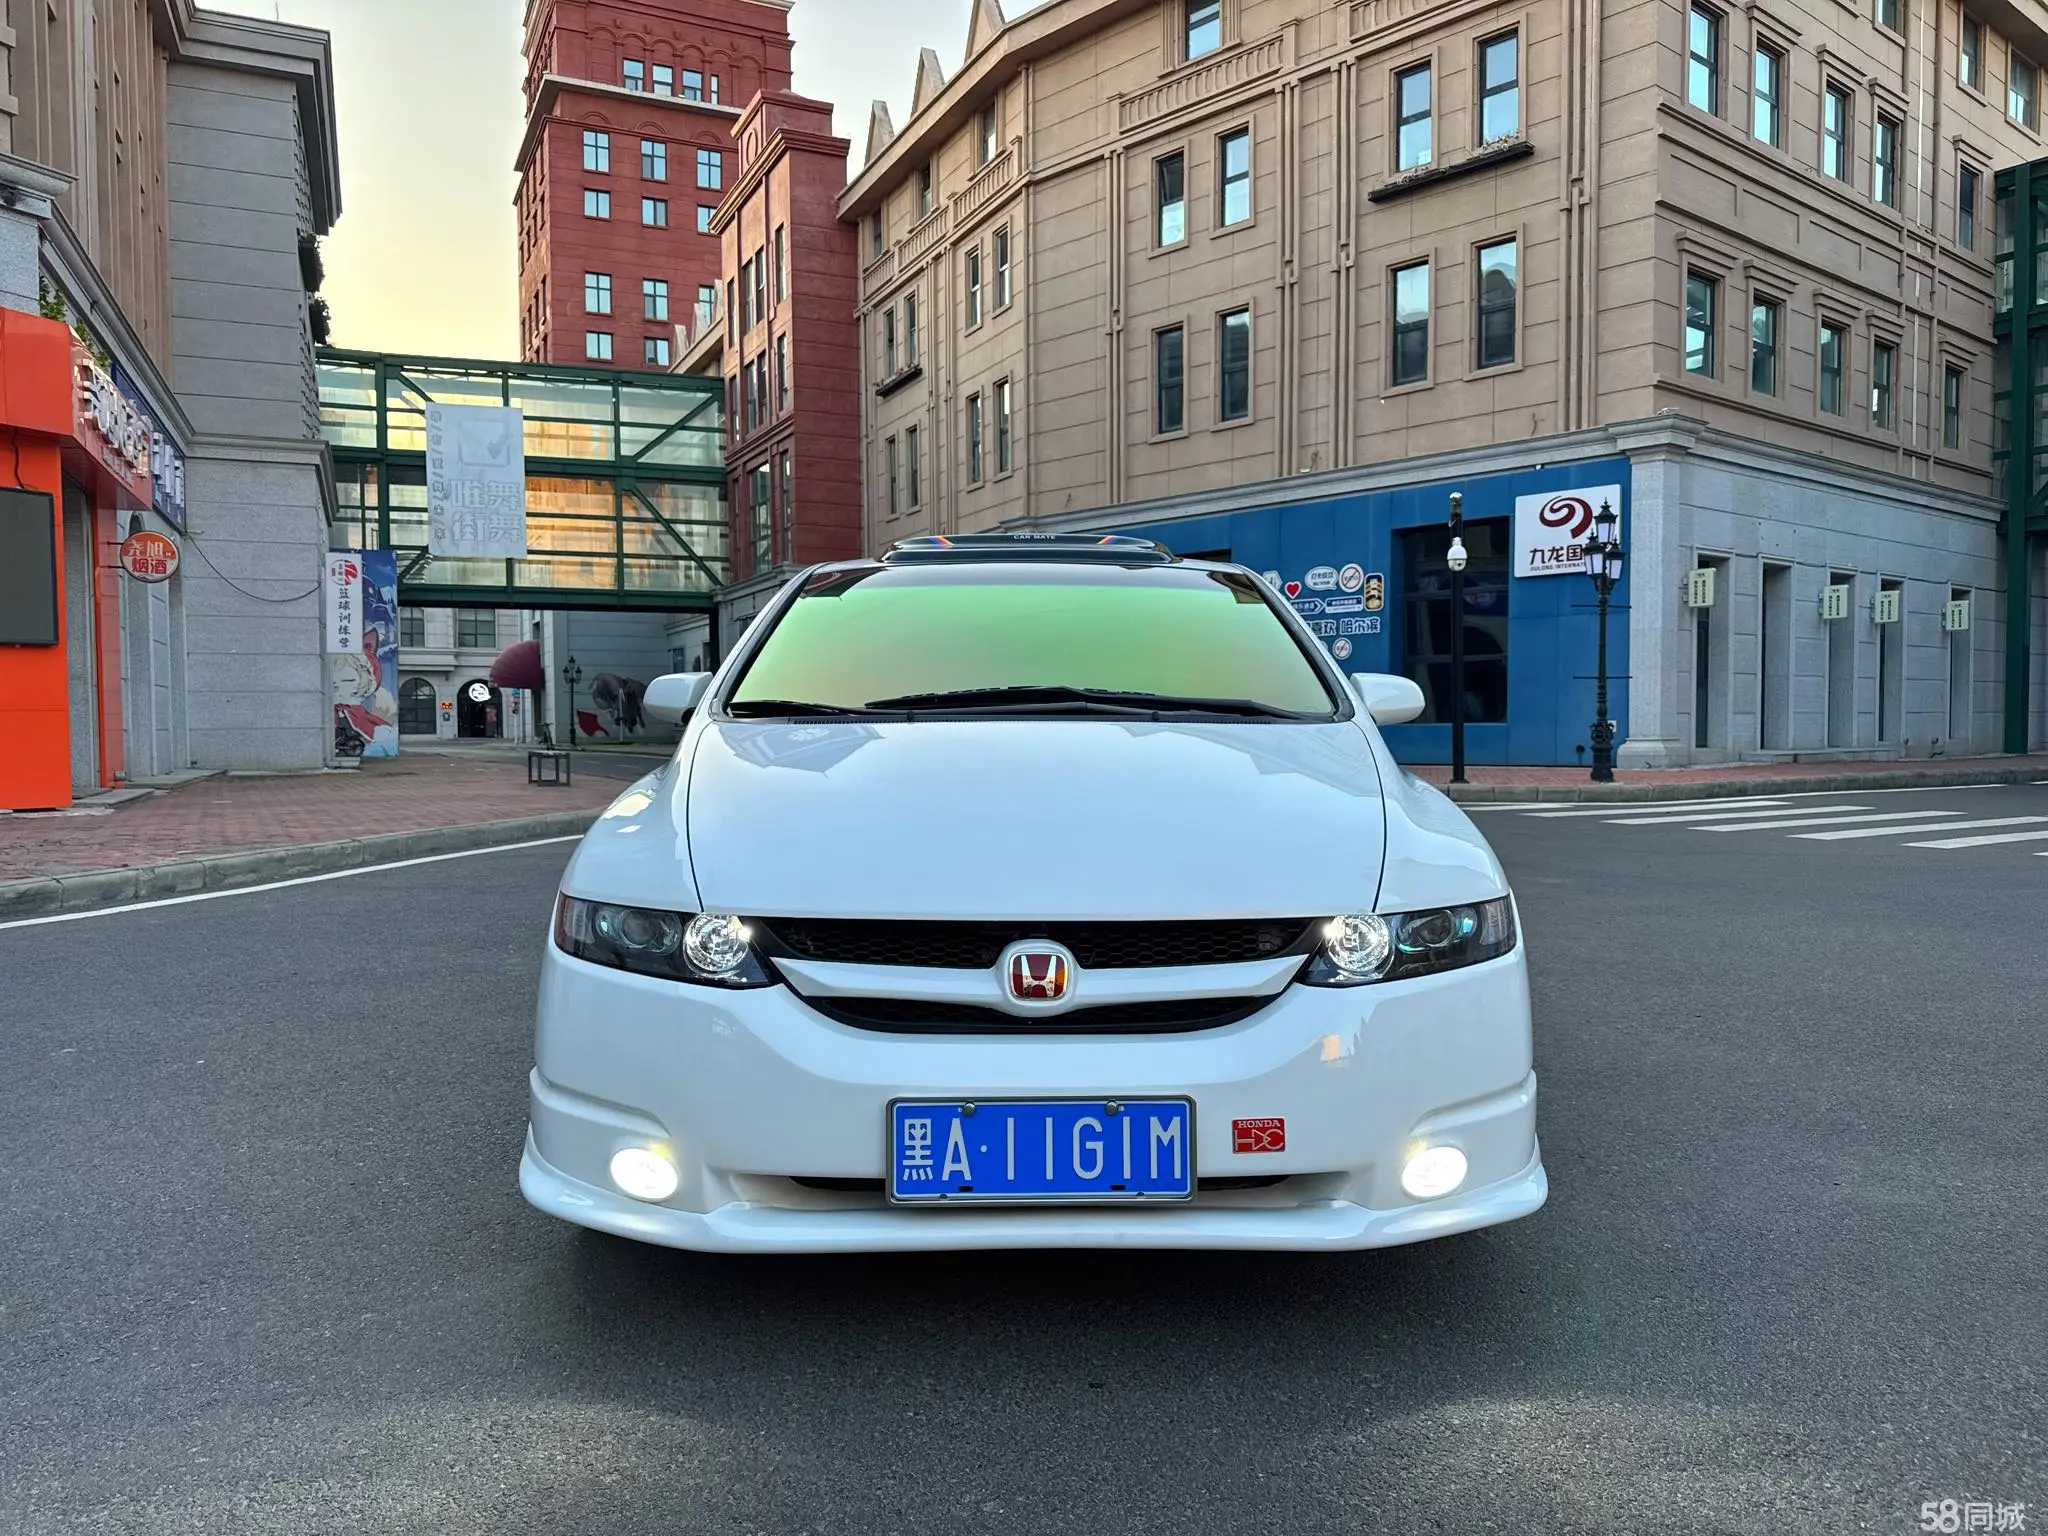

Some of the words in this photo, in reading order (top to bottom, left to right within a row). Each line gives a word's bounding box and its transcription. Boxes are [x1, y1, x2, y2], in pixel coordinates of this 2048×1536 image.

[1530, 544, 1583, 565] 九龙国
[132, 558, 167, 574] 烟酒
[1308, 620, 1335, 635] 喜欢
[1341, 617, 1379, 634] 哈尔滨
[1238, 1120, 1280, 1128] HONDA
